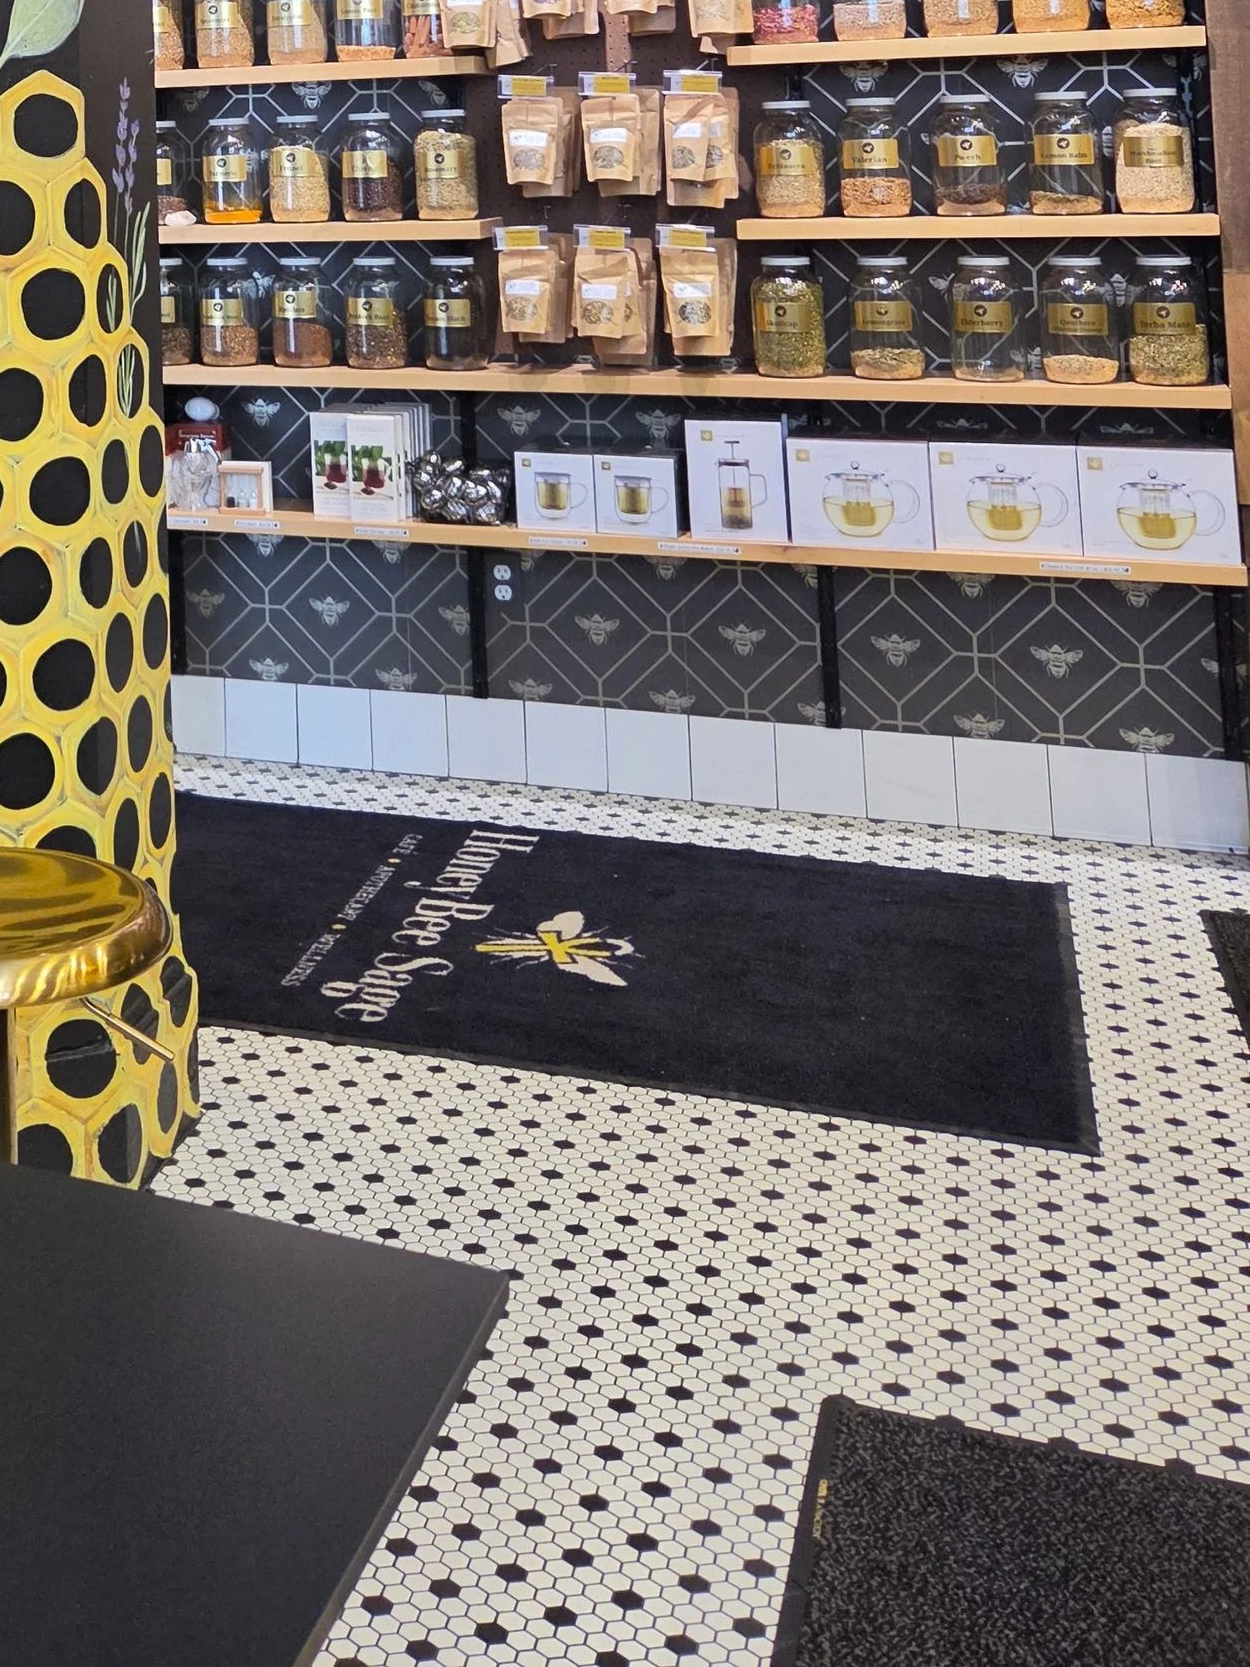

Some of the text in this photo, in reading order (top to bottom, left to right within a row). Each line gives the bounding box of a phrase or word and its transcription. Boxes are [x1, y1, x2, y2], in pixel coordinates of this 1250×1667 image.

[852, 156, 888, 164] Valerian
[961, 318, 1004, 327] Elderberry
[320, 829, 540, 1023] Honey Bee Sage
[281, 934, 342, 987] WELLNESS
